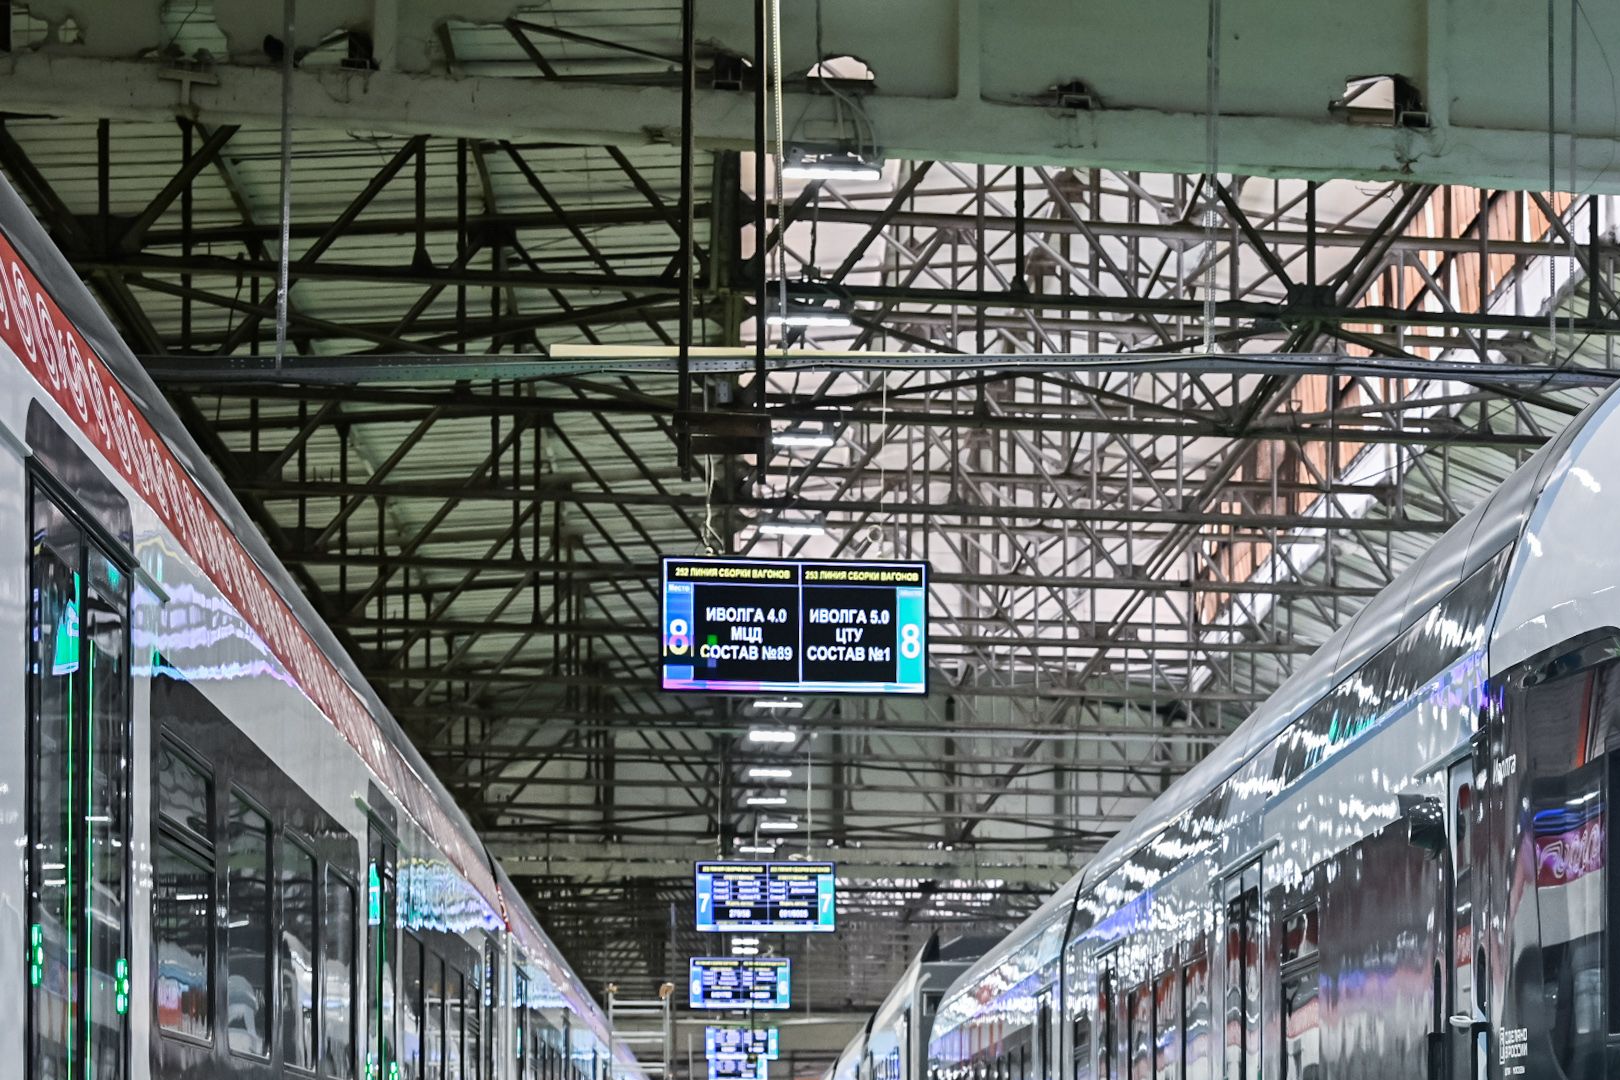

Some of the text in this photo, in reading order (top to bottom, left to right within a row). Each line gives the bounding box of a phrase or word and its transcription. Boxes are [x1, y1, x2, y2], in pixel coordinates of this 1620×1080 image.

[690, 567, 718, 578] ЛИНИЯ
[719, 568, 751, 578] СБОРКИ
[752, 569, 790, 579] ВАГОНОВ
[820, 571, 847, 580] ЛИНИЯ
[848, 571, 880, 581] СБОРКИ
[881, 572, 919, 582] ВАГОНОВ
[668, 584, 690, 593] Место
[706, 607, 787, 622] ИВОЛГА 4.0
[809, 608, 890, 624] ИВОЛГА 5.0
[669, 618, 688, 655] 8
[731, 626, 763, 643] МЦД
[835, 628, 863, 643] ЦТУ
[901, 623, 920, 659] 8
[700, 645, 793, 661] СОСТАВ №89
[807, 647, 890, 661] СОСТАВ №1
[699, 893, 711, 912] 7
[820, 894, 832, 912] 7
